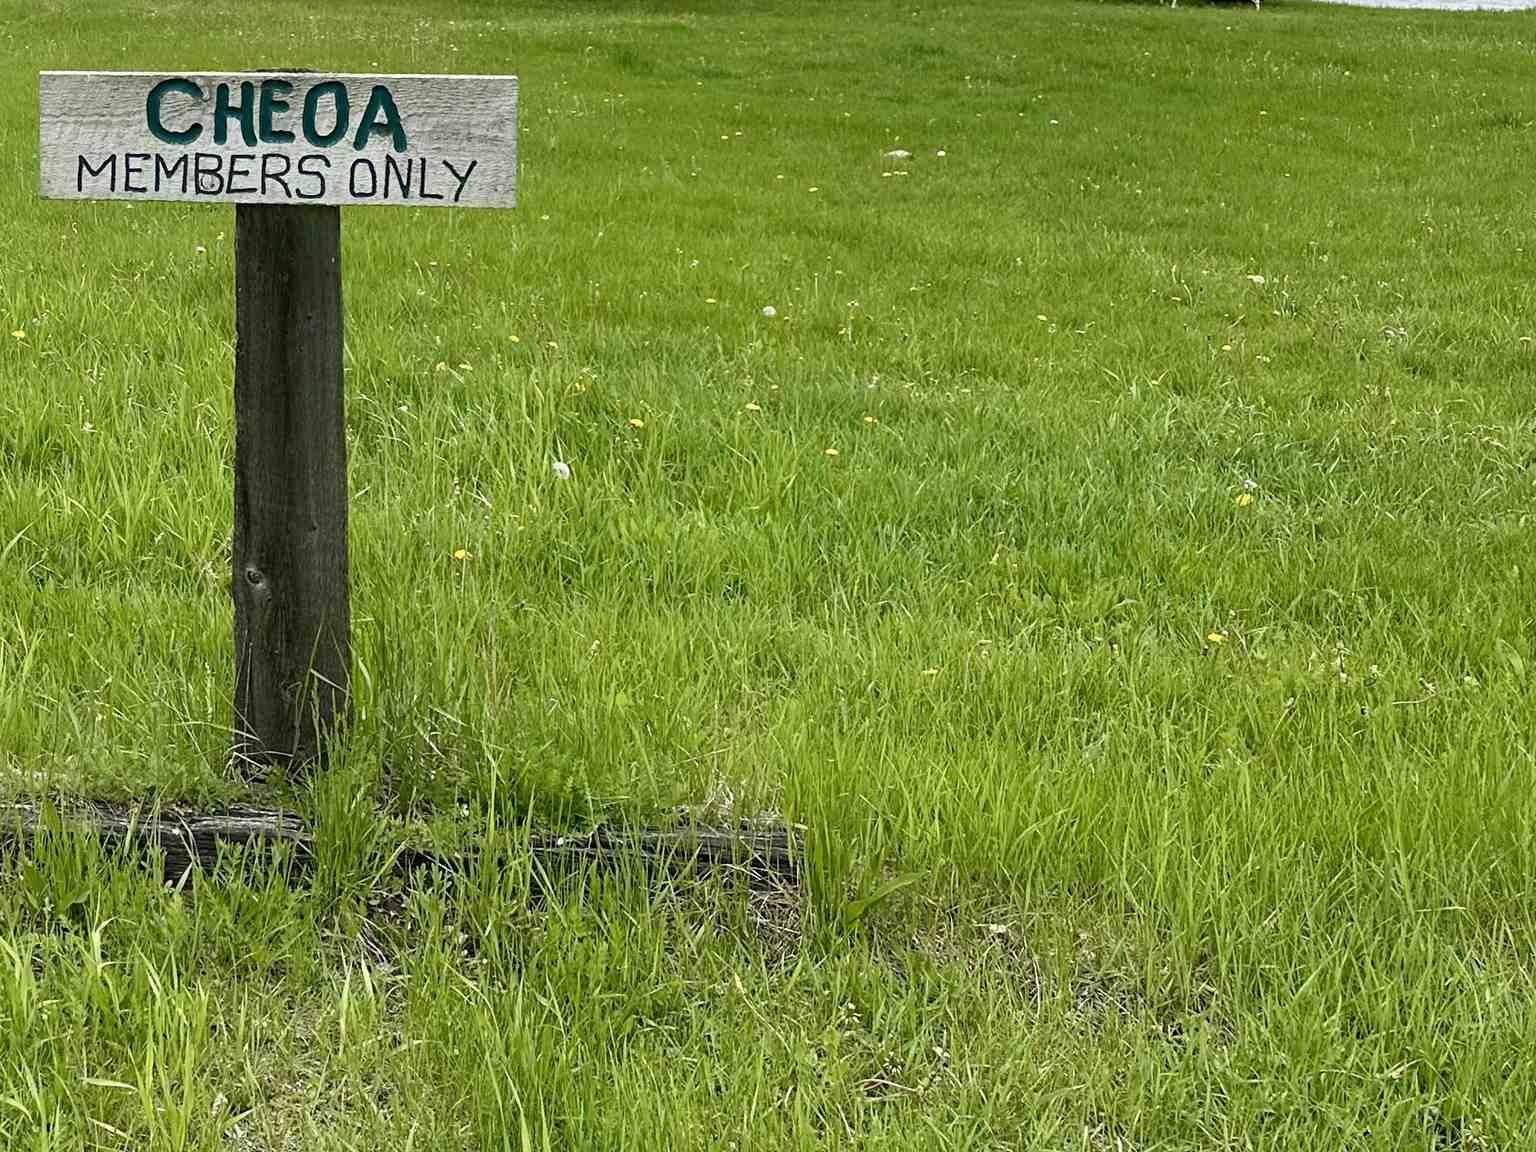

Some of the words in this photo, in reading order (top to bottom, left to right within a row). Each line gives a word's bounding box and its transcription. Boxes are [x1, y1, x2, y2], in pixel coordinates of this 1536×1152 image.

[146, 77, 408, 153] CHEOA
[76, 152, 331, 199] MEMBERS
[348, 154, 478, 202] ONLY
